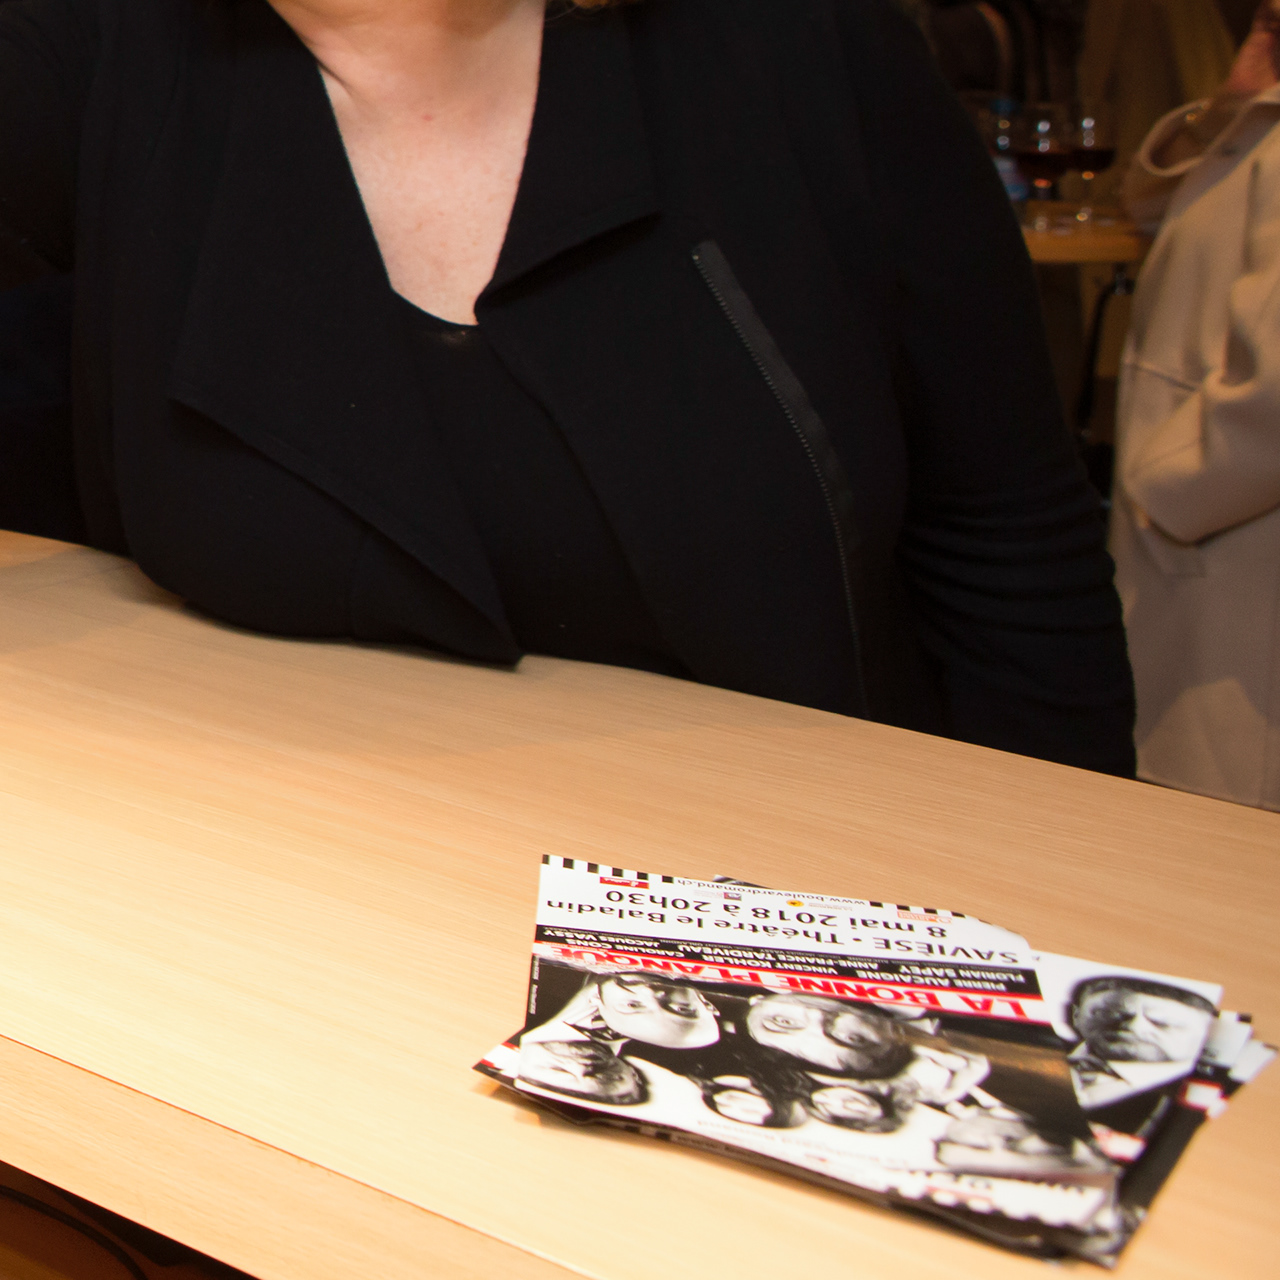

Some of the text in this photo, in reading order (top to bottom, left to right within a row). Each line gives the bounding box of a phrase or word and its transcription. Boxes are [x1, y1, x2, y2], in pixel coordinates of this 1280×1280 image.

[607, 890, 712, 913] 20h30
[678, 878, 865, 907] www.boulevardromand.ch
[722, 902, 741, 918] à
[752, 906, 838, 928] 2018
[548, 899, 1019, 964] SAVIÈSE Théâtre le Baladin
[851, 915, 915, 933] mai
[926, 925, 947, 939] 8
[545, 928, 597, 942] VASSY
[602, 933, 660, 949] JACQUES
[567, 938, 612, 953] CONS
[616, 943, 686, 959] CAROLINE
[679, 944, 778, 962] TARDIVEAU
[553, 947, 764, 984] PLANQUE
[704, 953, 839, 977] VINCENT KOHLER
[779, 953, 879, 971] ANNE-FRANCE
[899, 963, 956, 978] SAPEY
[858, 969, 1008, 993] PIERRE AUCAIGNE
[962, 967, 1026, 983] FLORIAN
[781, 973, 944, 1008] BONNE
[958, 993, 1028, 1019] LA
